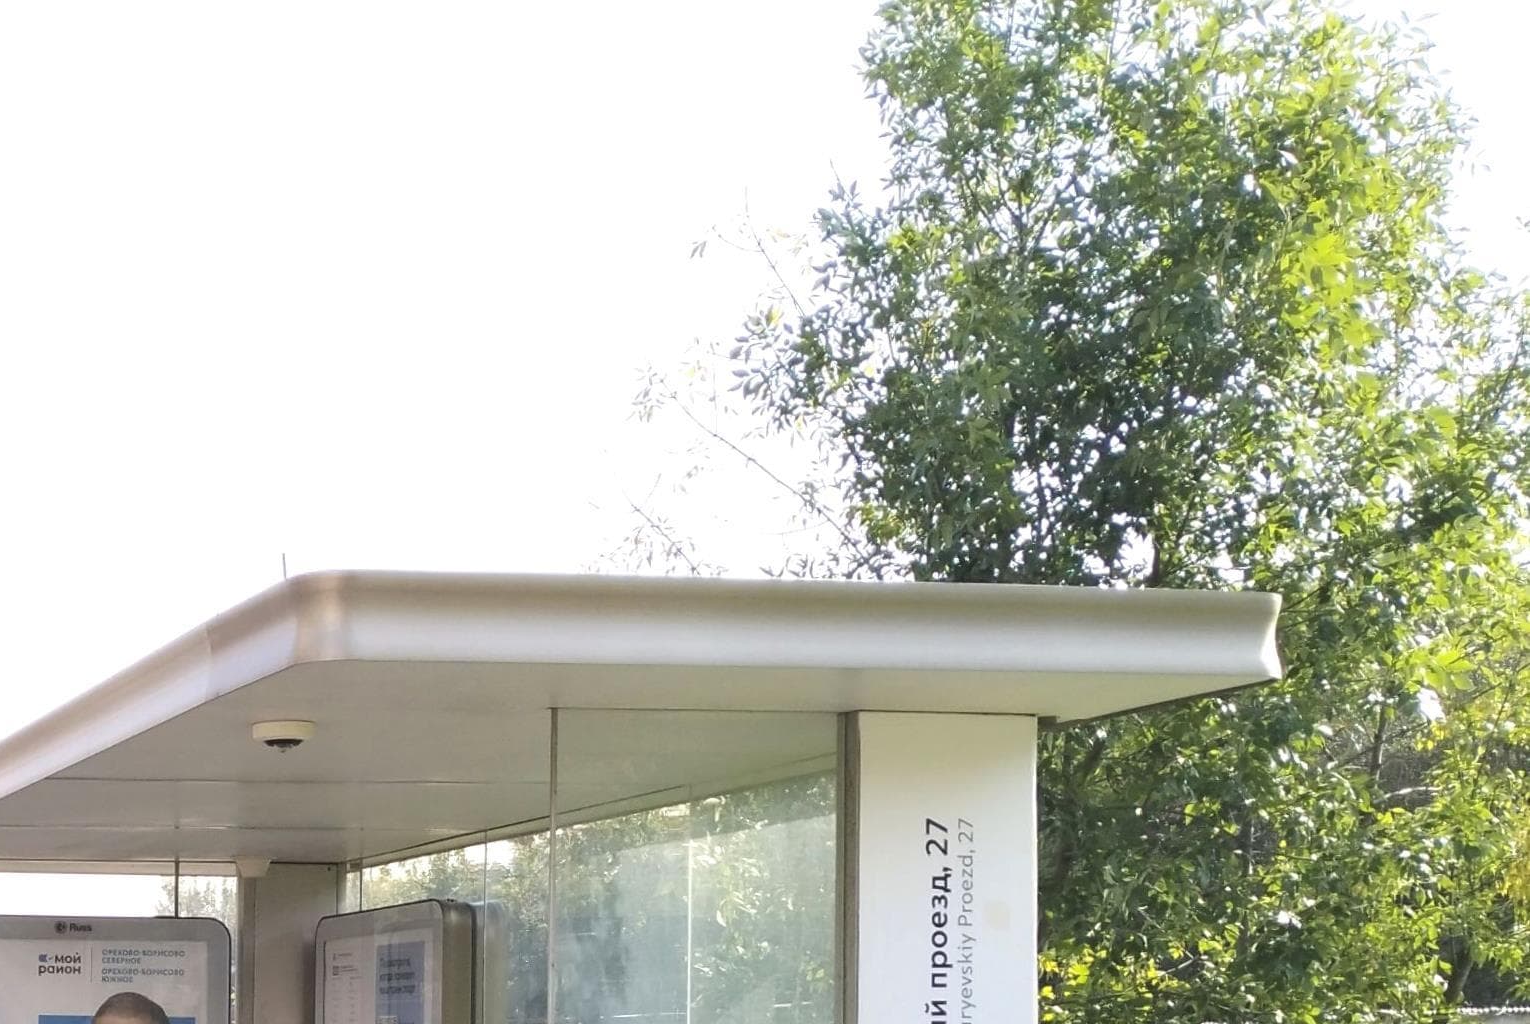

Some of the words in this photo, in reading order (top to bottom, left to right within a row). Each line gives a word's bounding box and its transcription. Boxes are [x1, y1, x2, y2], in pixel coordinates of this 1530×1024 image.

[926, 818, 949, 856] 27
[957, 818, 973, 842] 27
[957, 849, 976, 926] Proezd,
[930, 866, 953, 988] проезд,
[55, 952, 81, 964] мой
